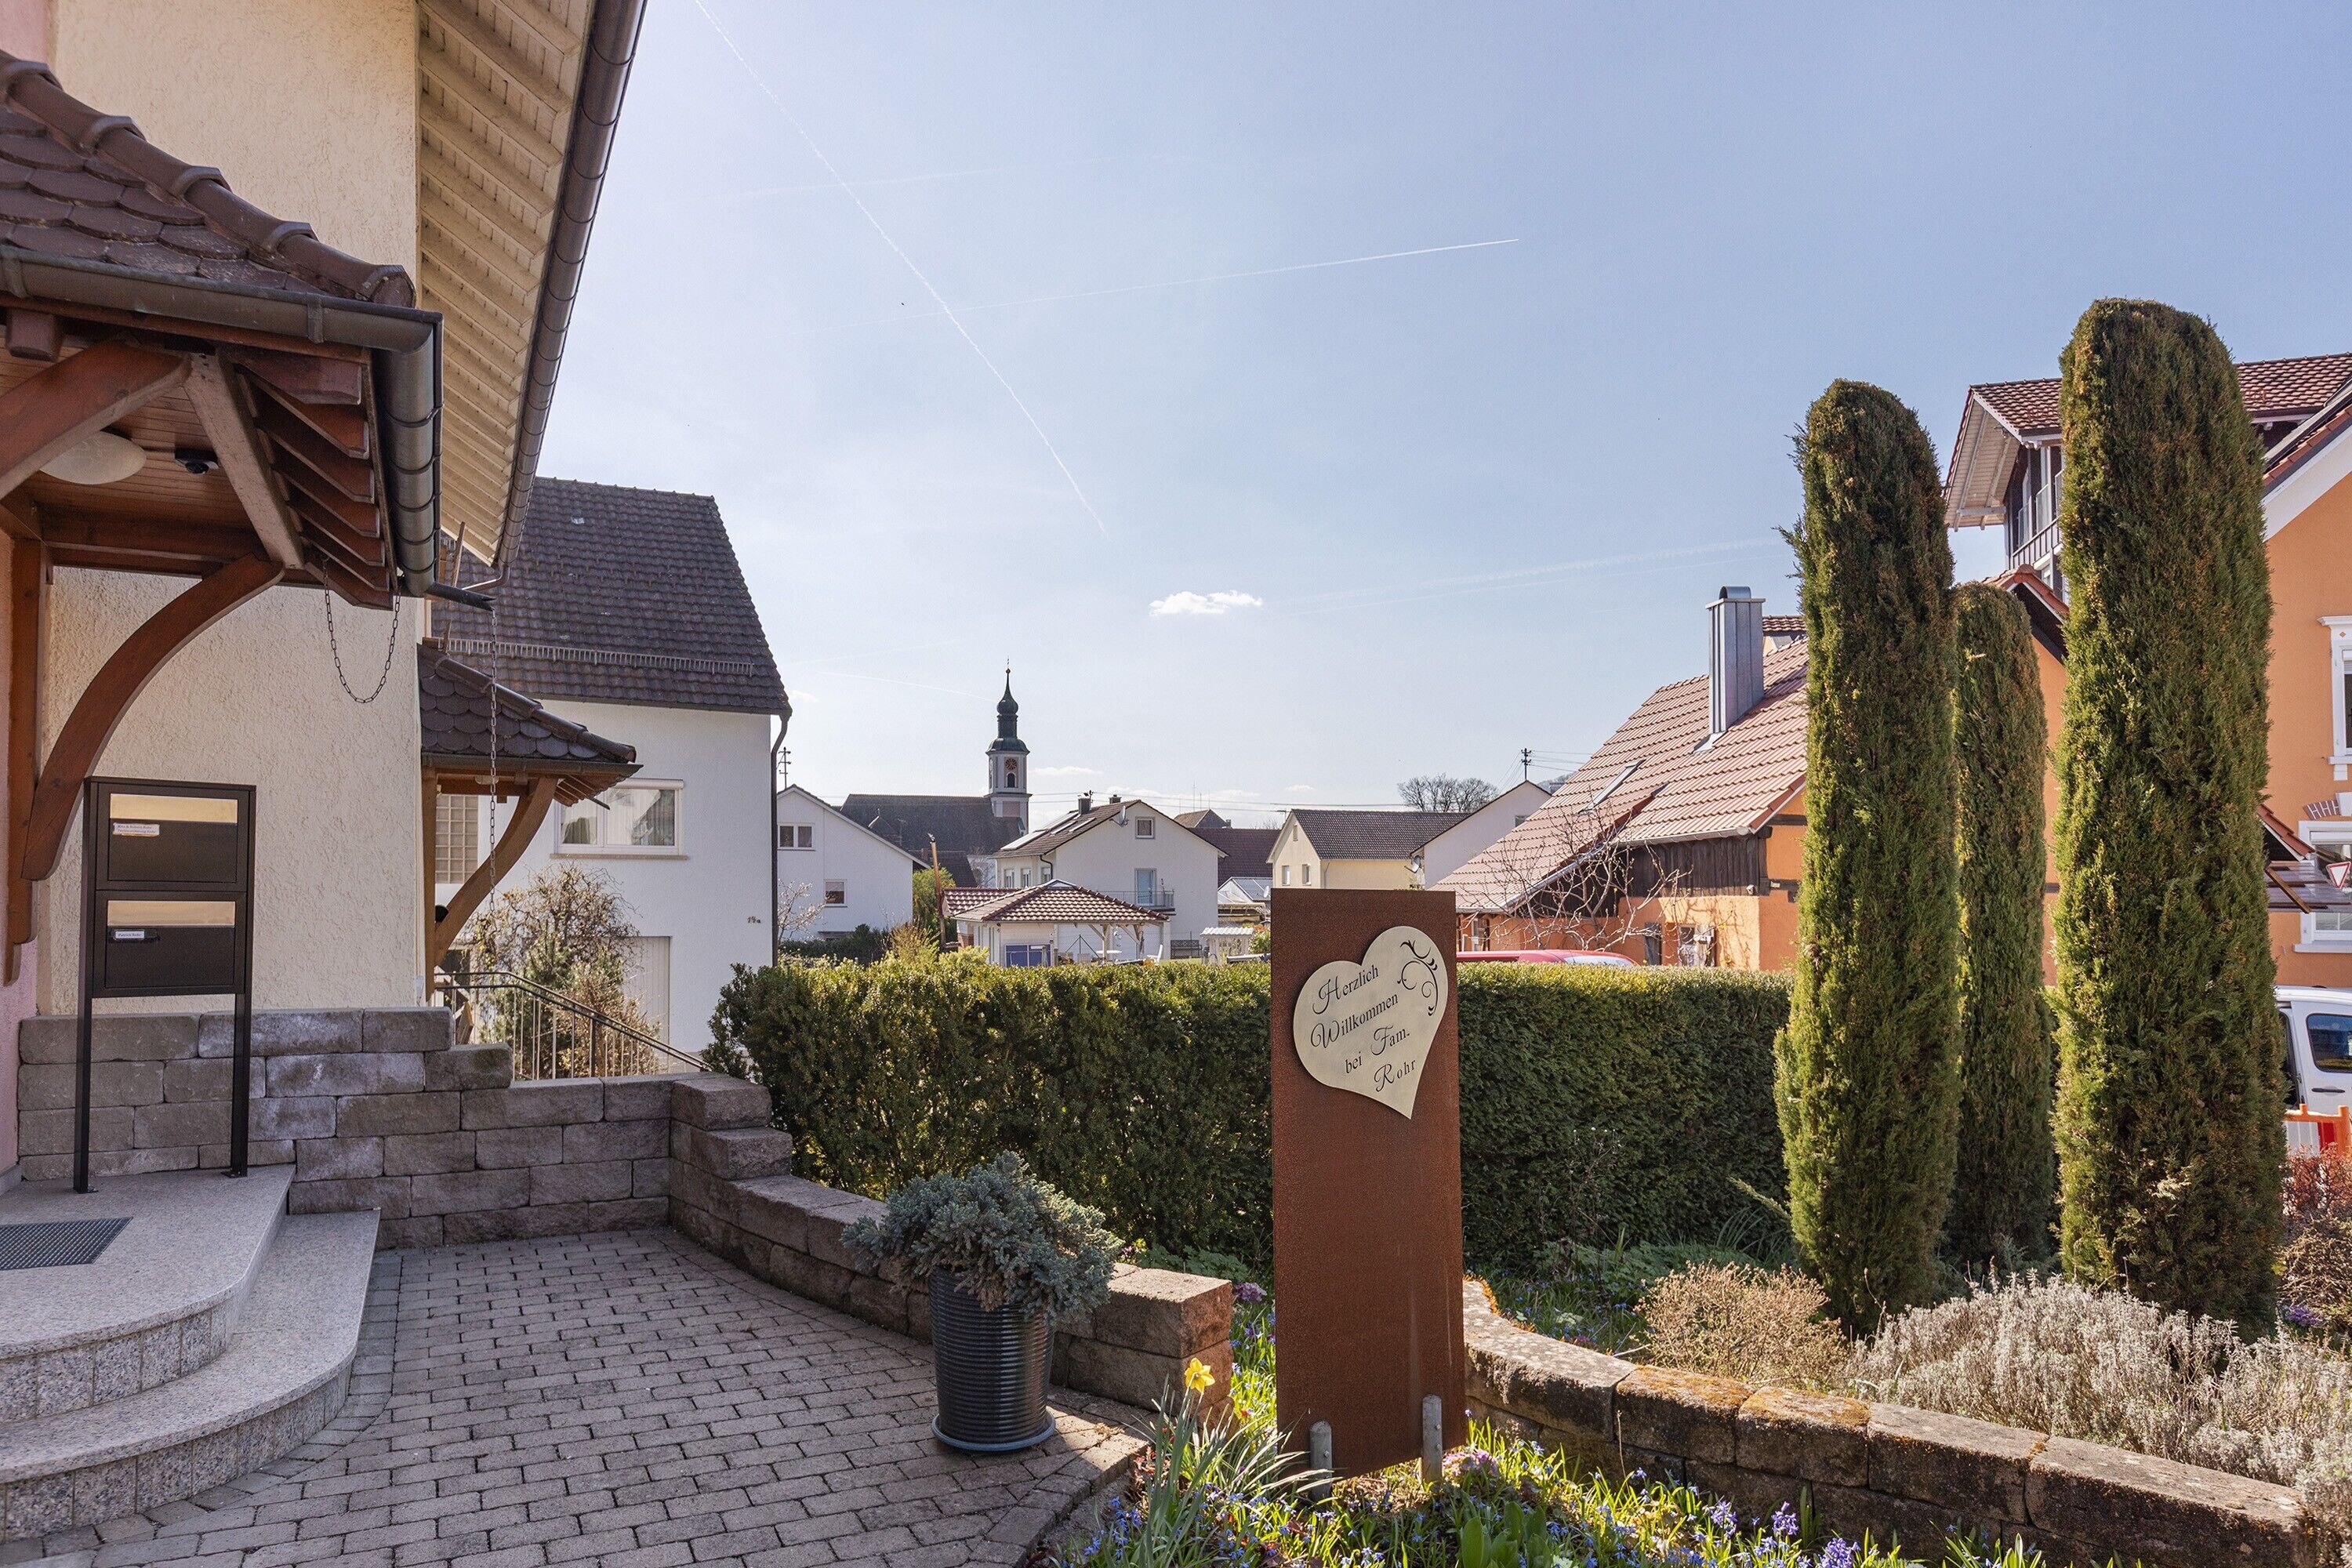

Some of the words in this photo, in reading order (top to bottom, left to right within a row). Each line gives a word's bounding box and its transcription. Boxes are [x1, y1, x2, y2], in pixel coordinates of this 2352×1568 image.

[1312, 965, 1379, 1014] Herzlich
[1311, 993, 1399, 1048] Willkommen
[1345, 1051, 1363, 1074] bei
[1370, 1025, 1410, 1055] Fam.
[1374, 1059, 1416, 1092] Rohr
